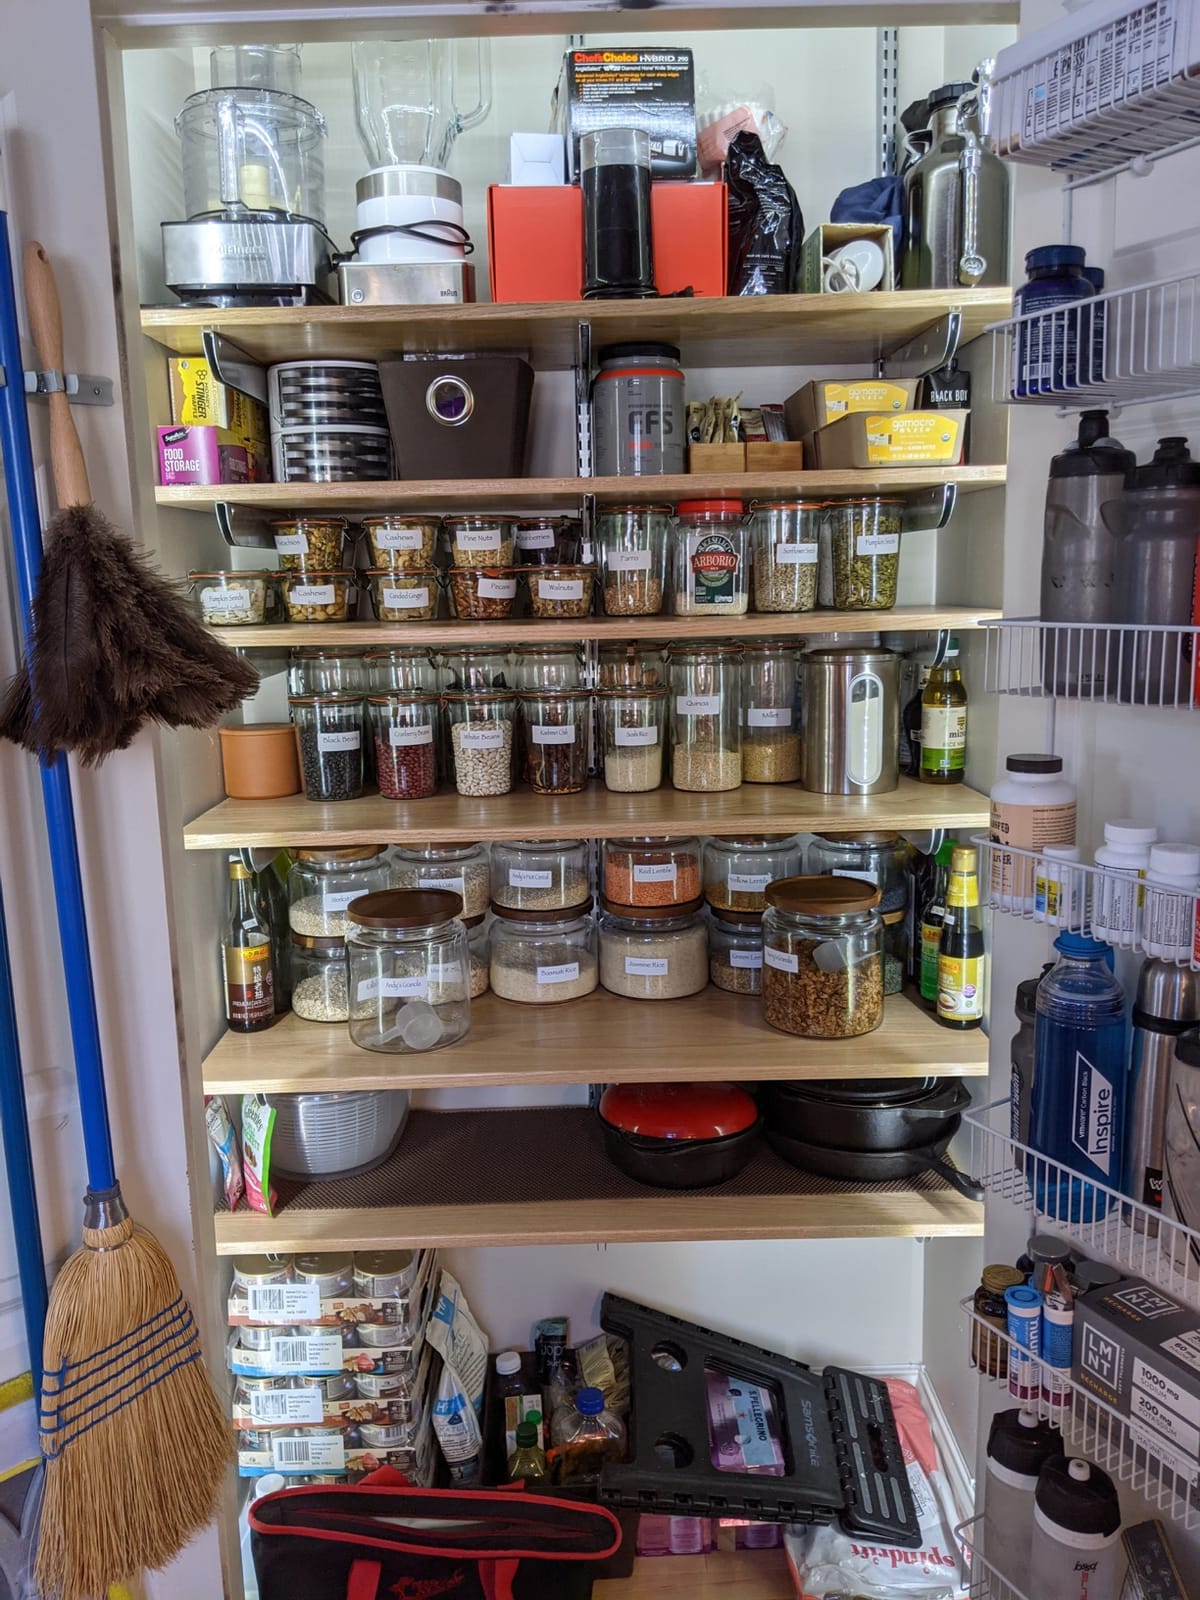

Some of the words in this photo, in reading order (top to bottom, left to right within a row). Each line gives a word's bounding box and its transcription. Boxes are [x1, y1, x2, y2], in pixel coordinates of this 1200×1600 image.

[195, 381, 207, 419] STINGER
[930, 390, 953, 402] BLACK
[163, 448, 184, 460] FOOD
[163, 460, 201, 472] STORAGE
[693, 555, 736, 568] ARBORIO
[1089, 1088, 1111, 1155] Inspire
[1141, 1366, 1166, 1390] 1000
[1166, 1386, 1180, 1401] mg
[1138, 1396, 1159, 1416] 200
[1159, 1413, 1173, 1427] mg
[801, 1399, 821, 1467] Samsonite
[850, 1543, 955, 1574] spindrift
